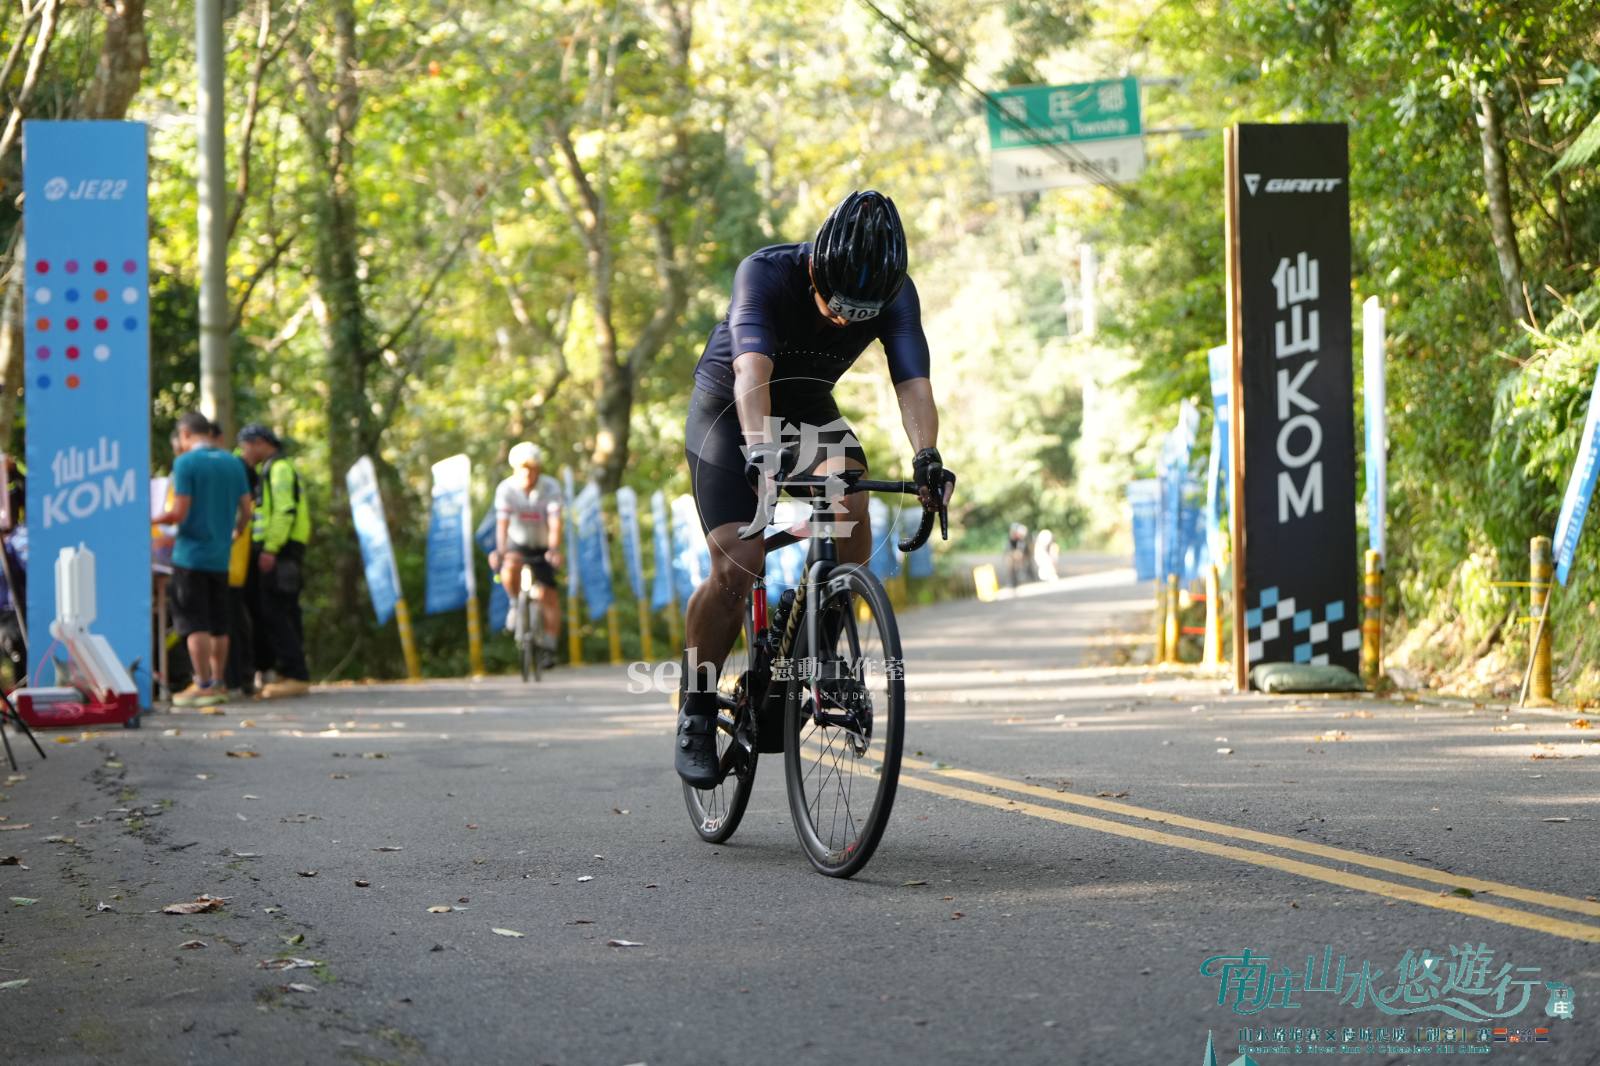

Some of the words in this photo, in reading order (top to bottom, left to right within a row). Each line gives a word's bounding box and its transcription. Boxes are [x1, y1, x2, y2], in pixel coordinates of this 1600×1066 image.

[69, 179, 128, 200] JE22
[1265, 177, 1342, 193] GIANT
[51, 436, 119, 488] 仙山
[43, 467, 136, 529] KOM
